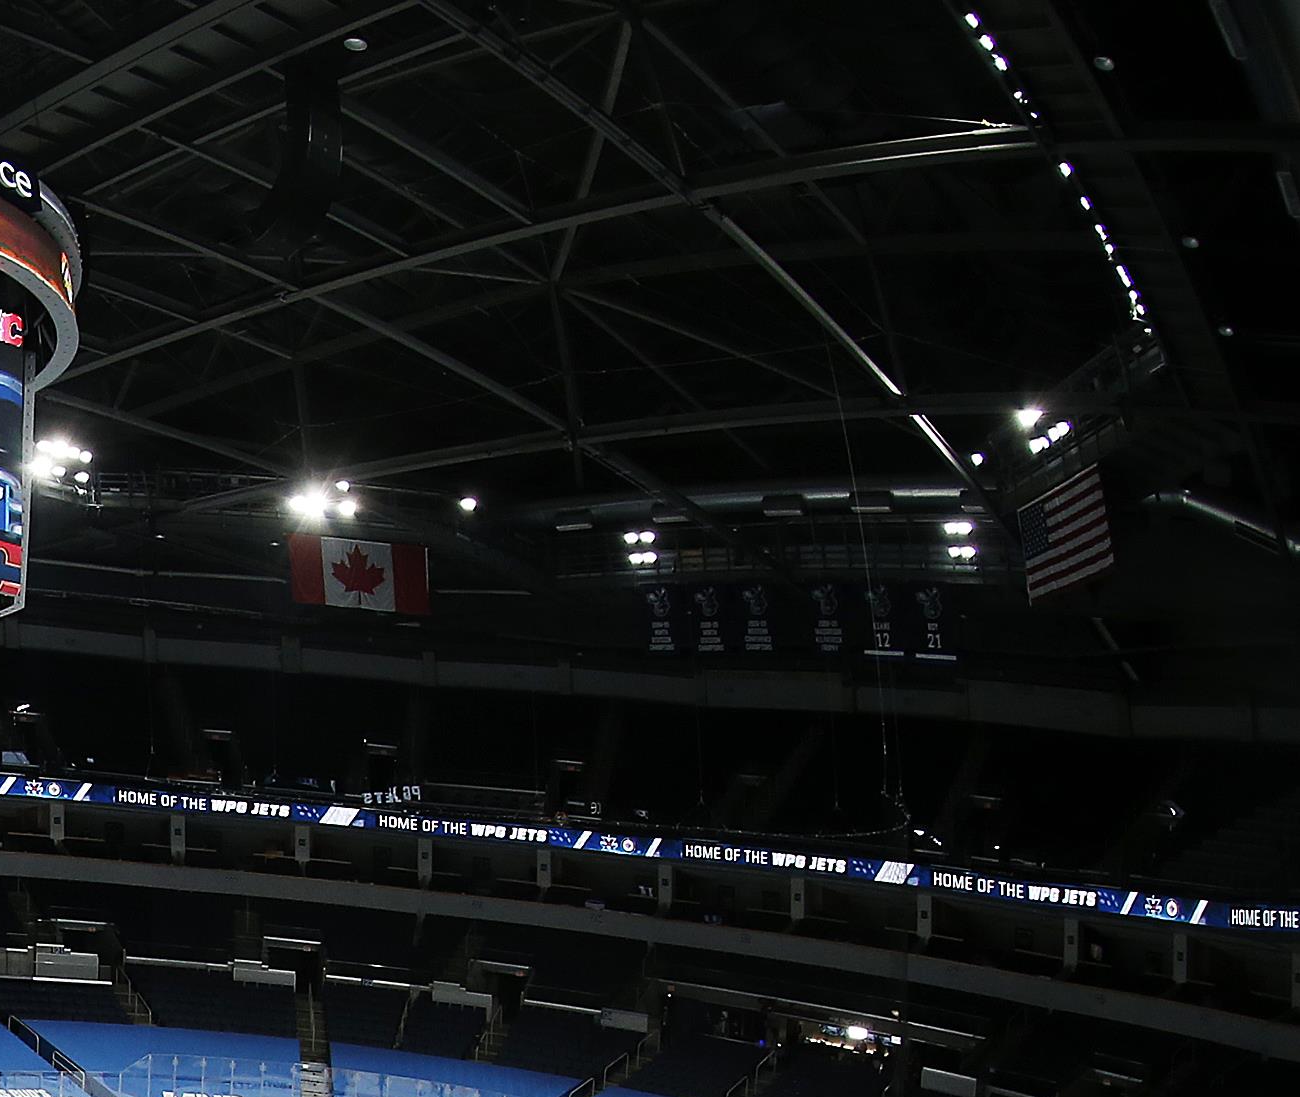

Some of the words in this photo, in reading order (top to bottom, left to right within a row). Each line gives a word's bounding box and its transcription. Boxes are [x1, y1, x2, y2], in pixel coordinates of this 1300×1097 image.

[118, 789, 157, 806] HOME
[160, 794, 178, 808] OF
[180, 796, 207, 811] THE
[210, 798, 248, 814] WPG
[250, 802, 291, 818] JETS
[379, 814, 418, 831] HOME
[422, 819, 439, 833] OF
[441, 820, 467, 836] THE
[470, 823, 507, 839] WPG
[508, 827, 548, 843] JETS
[685, 844, 722, 860] HOME
[724, 847, 741, 862] OF
[743, 849, 768, 865] THE
[771, 852, 807, 869] WPG
[808, 856, 847, 874] JETS
[933, 871, 973, 891] HOME
[977, 878, 995, 894] OF
[997, 880, 1025, 899] THE
[1027, 885, 1061, 903] WPG
[1061, 888, 1097, 908] JETS
[1231, 908, 1261, 927] HOME
[1262, 909, 1277, 927] OF
[1278, 910, 1300, 929] THE
